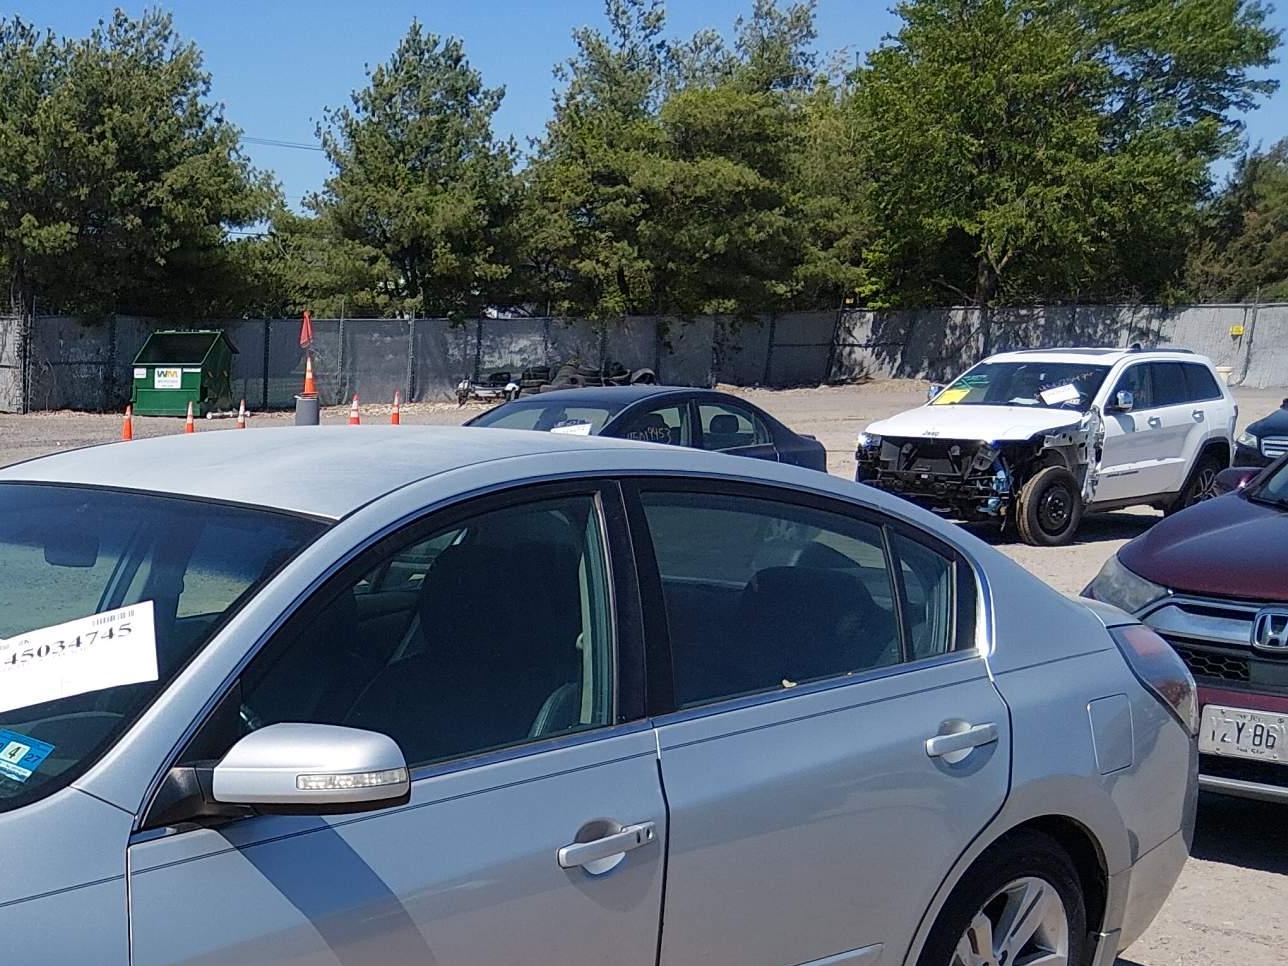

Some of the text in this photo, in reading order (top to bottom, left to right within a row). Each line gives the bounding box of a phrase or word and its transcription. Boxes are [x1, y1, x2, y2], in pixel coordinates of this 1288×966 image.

[156, 370, 179, 378] WM
[3, 622, 133, 665] 45034745
[8, 746, 22, 759] 4
